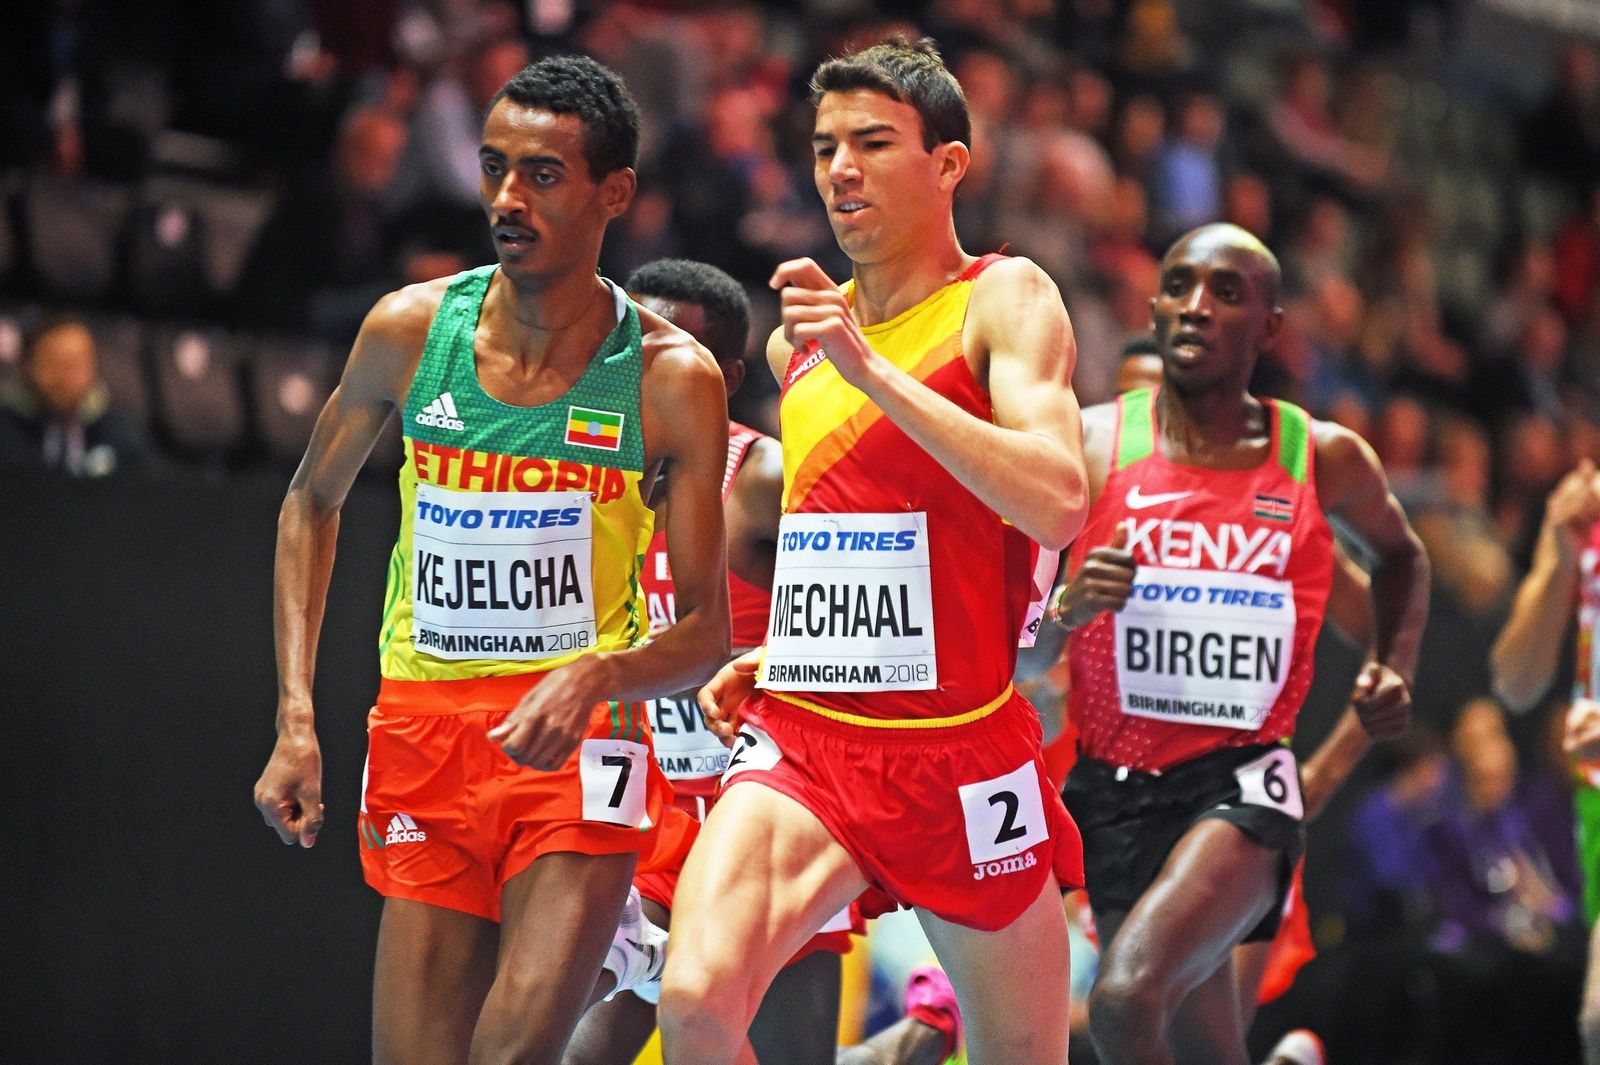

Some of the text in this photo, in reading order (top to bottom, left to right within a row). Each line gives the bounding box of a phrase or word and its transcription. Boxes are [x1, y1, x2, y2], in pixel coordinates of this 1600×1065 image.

[415, 412, 465, 432] adidas
[412, 439, 626, 505] ETHIOPIA
[417, 501, 582, 530] TOYO TIRES
[782, 530, 917, 552] TOYO TIRES
[1125, 517, 1292, 577] KENYA
[416, 549, 584, 611] KEJELCHA
[1130, 583, 1286, 610] TOYO TIRES
[772, 583, 923, 638] MECHAAL
[418, 628, 590, 653] BIRMINGHAM 2018
[1125, 626, 1282, 684] BIRGEN
[768, 663, 929, 684] BIRMINGHAM 2018
[1127, 693, 1246, 721] BIRMINGHAM
[601, 755, 632, 809] 7
[694, 754, 729, 773] 2018
[1263, 760, 1289, 805] 6
[987, 790, 1028, 845] 2
